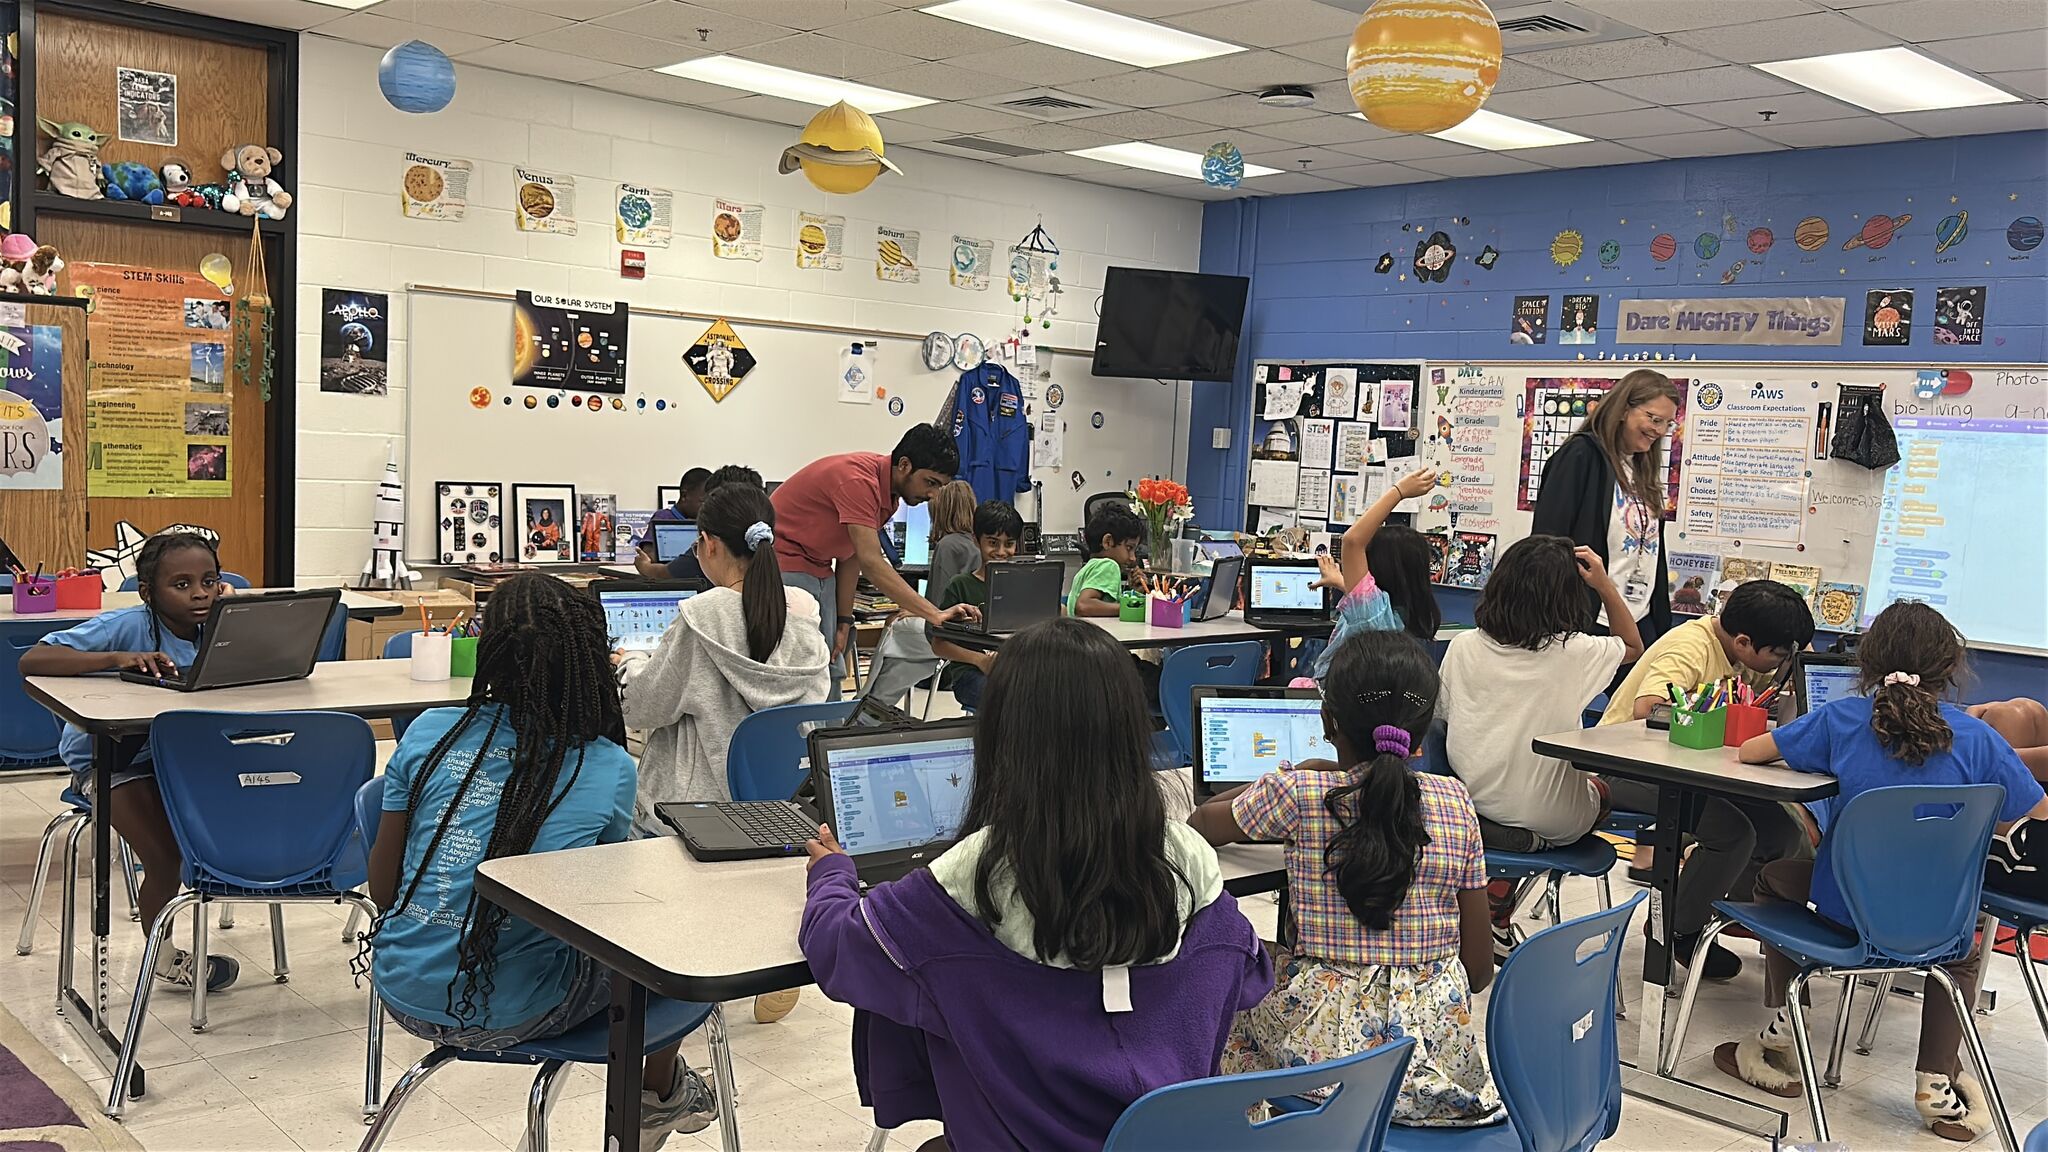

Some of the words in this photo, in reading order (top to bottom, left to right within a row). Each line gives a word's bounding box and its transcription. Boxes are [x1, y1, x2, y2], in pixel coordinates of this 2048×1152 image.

[405, 152, 451, 168] Mercury
[516, 169, 554, 185] Venus
[620, 183, 650, 196] Earth
[716, 200, 743, 213] Mars
[877, 226, 905, 239] Saturn
[123, 270, 153, 282] STEM
[155, 274, 185, 285] Skills
[534, 294, 553, 304] OUR
[584, 300, 612, 311] SYSTEM
[1521, 300, 1540, 308] SPACE
[331, 304, 379, 318] APOLLO
[1517, 307, 1545, 315] STATION
[1626, 311, 1670, 331] Dare
[1675, 311, 1759, 331] MIGHTY
[1766, 309, 1831, 337] Things
[706, 332, 736, 342] ASTRONAUT
[1872, 327, 1902, 338] MARS
[1457, 366, 1483, 378] DATE
[704, 376, 734, 386] CROSSING
[1479, 375, 1504, 386] CAN
[1459, 387, 1502, 396] Kindergarten
[1750, 389, 1784, 400] PAWS
[1727, 403, 1761, 411] Classroom
[1762, 404, 1806, 412] Expectations
[1464, 417, 1485, 425] Grade
[1700, 419, 1718, 427] Pride
[1307, 424, 1330, 434] STEM
[1451, 444, 1462, 452] 2nd
[1691, 453, 1721, 461] Attitude
[1460, 475, 1480, 483] Grade
[1695, 476, 1713, 484] Wise
[1690, 486, 1716, 495] Choices
[1690, 509, 1713, 519] Safety
[1669, 558, 1715, 570] HONEYBEE
[456, 750, 477, 760] Evely
[450, 771, 467, 780] Dyla
